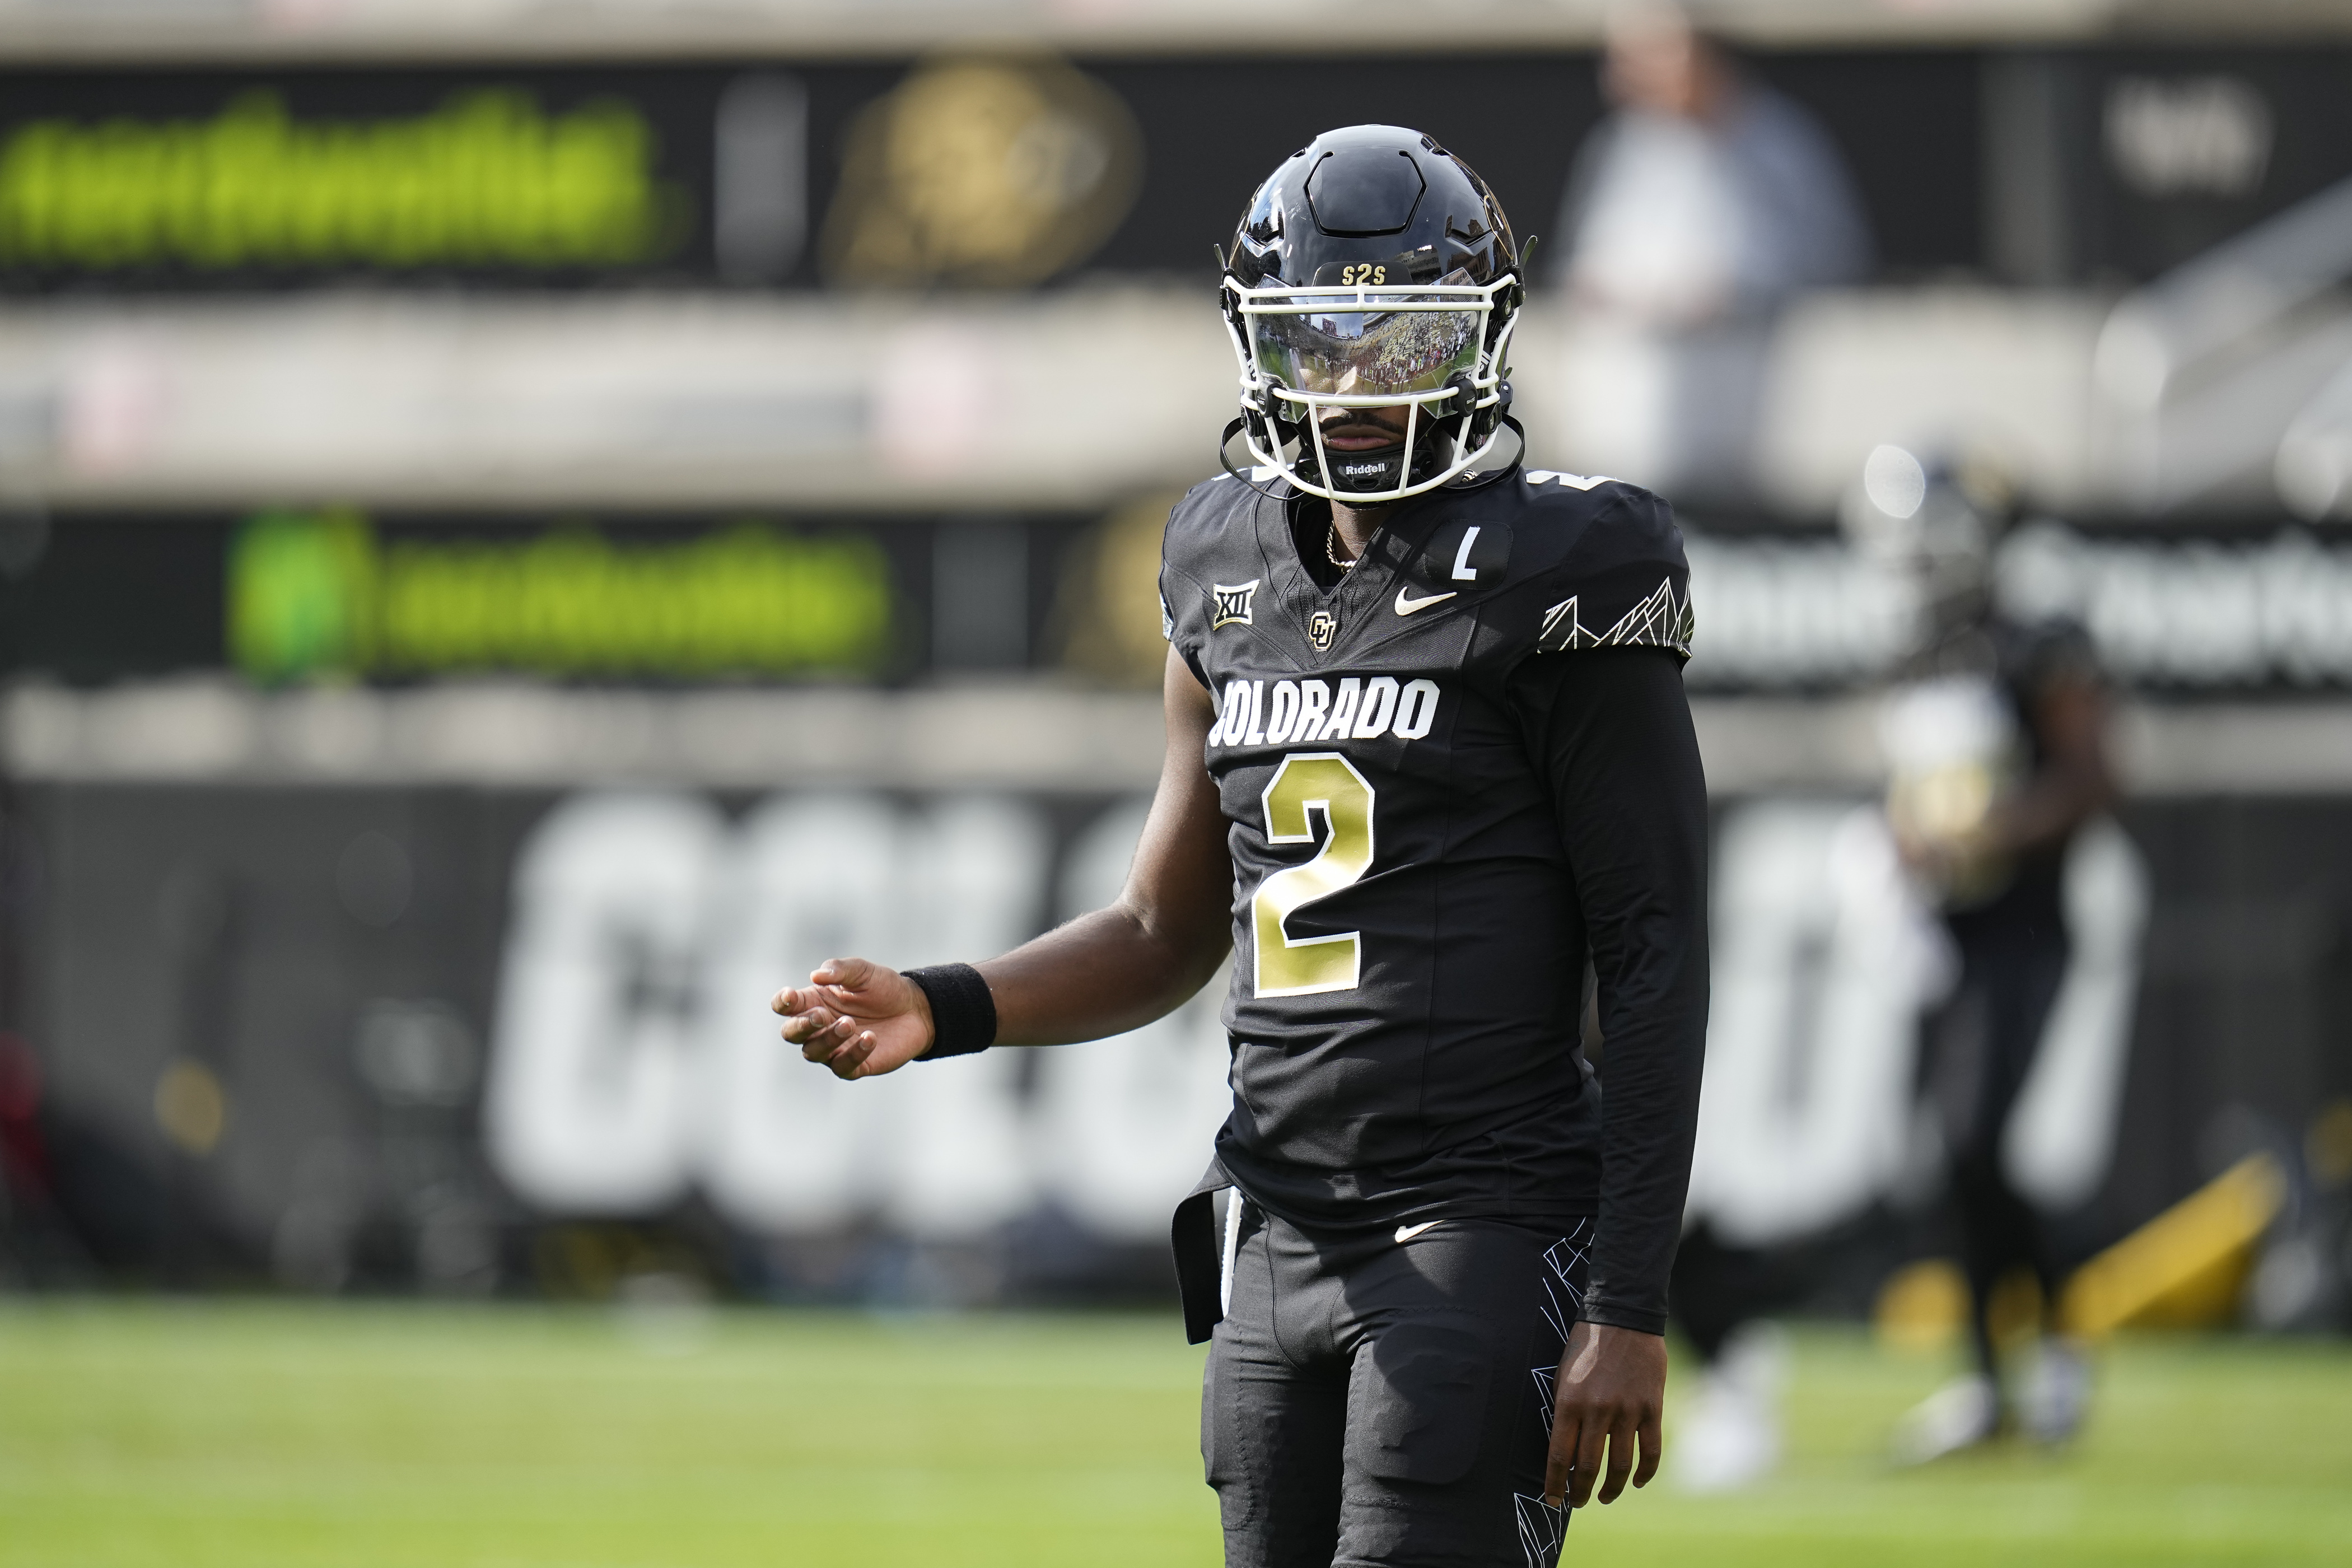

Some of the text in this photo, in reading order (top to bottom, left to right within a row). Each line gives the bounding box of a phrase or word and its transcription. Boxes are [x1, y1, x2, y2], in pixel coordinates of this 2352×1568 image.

[1342, 264, 1385, 286] S2S
[1346, 463, 1385, 474] Riddell
[1452, 526, 1481, 580] L
[1309, 613, 1336, 648] CU
[1252, 752, 1375, 998] 2
